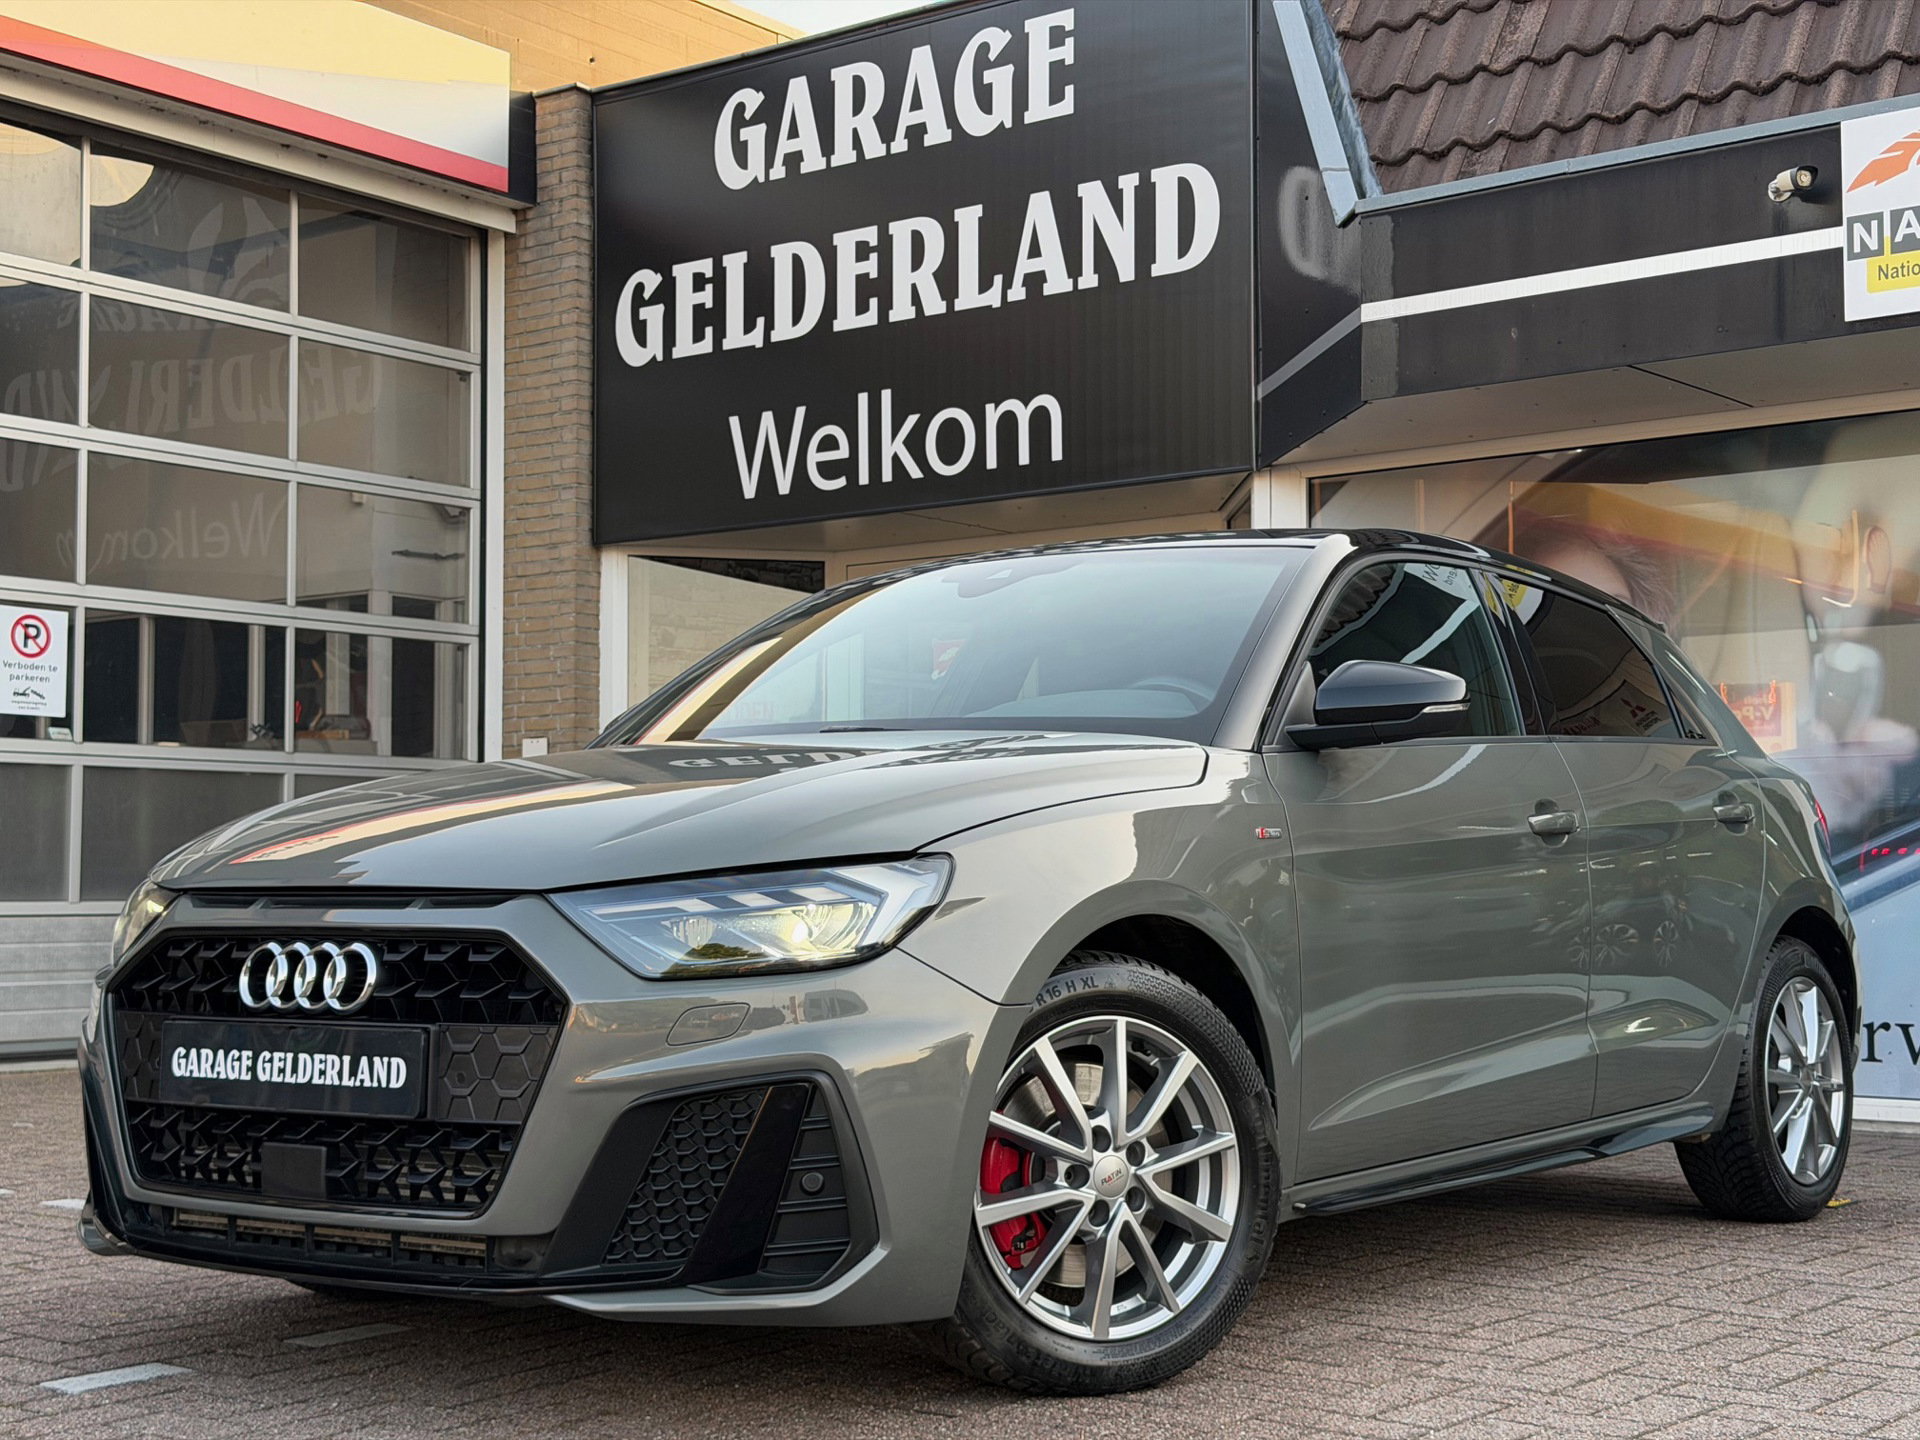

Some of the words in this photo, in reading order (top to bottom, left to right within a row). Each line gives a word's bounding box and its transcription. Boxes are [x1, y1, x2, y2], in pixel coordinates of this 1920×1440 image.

[713, 7, 1075, 190] GARAGE
[615, 162, 1221, 367] GELDERLAND
[728, 389, 1063, 499] Welkom
[2, 659, 46, 671] Verboden
[48, 664, 58, 673] te
[9, 672, 50, 684] parkeren
[1065, 979, 1077, 994] H
[1080, 975, 1099, 990] XL
[171, 1047, 253, 1081] GARAGE
[256, 1050, 407, 1089] GELDERLAND
